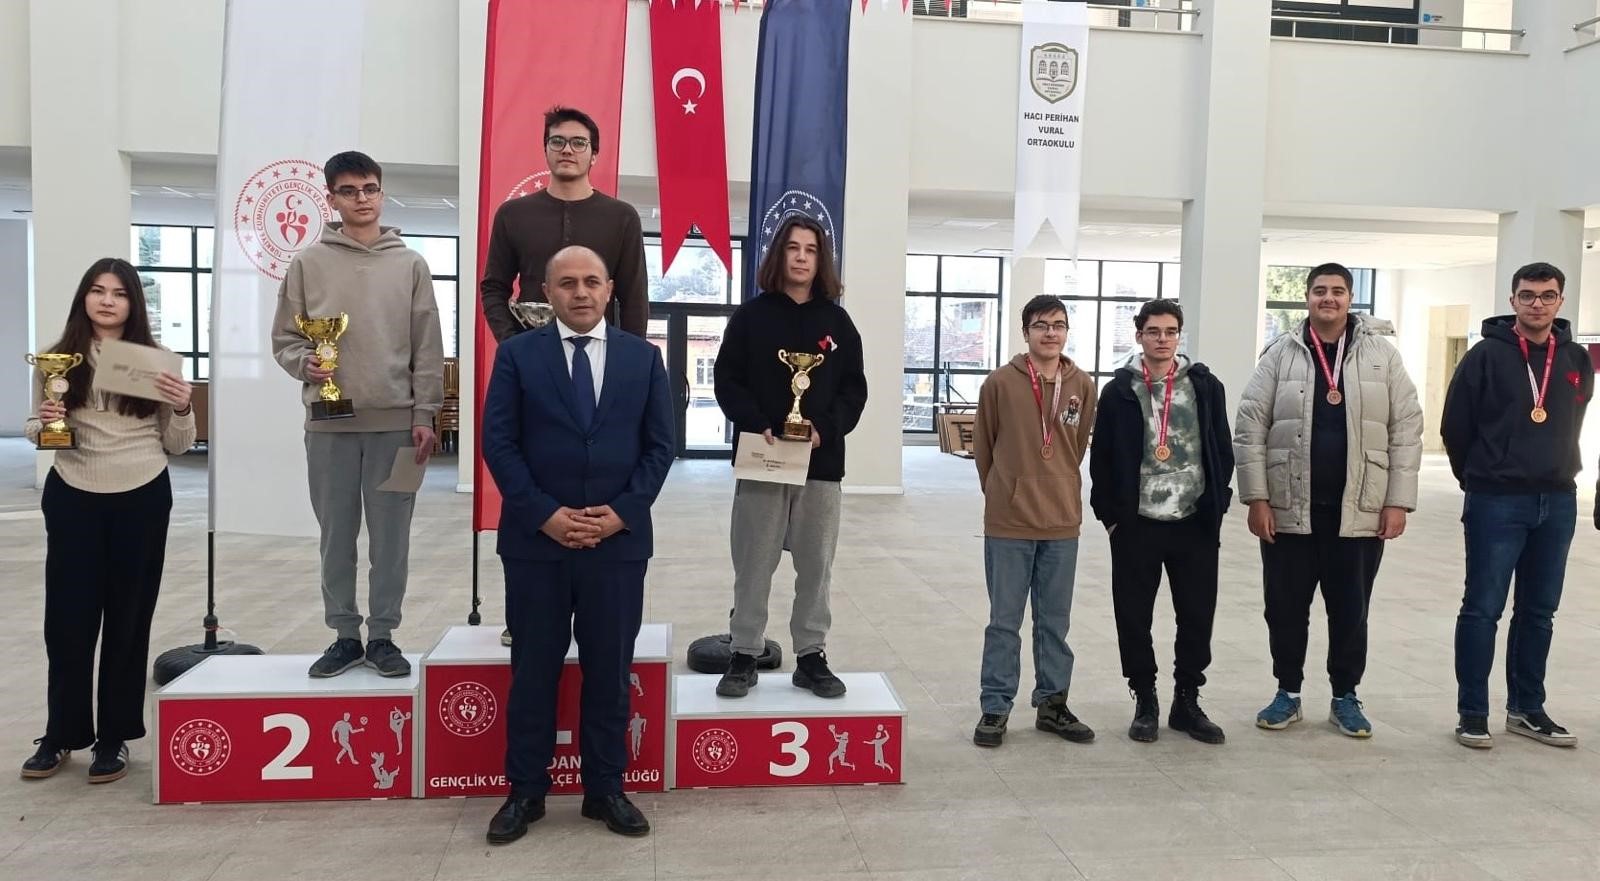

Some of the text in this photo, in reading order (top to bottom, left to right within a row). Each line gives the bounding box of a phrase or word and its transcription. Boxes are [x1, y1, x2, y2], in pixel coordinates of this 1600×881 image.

[1024, 112, 1079, 123] HACI PERİHAN
[1038, 126, 1064, 135] VURAL
[1027, 138, 1075, 148] ORTAOKULU
[313, 192, 322, 202] VE
[261, 713, 313, 780] 2
[769, 721, 810, 777] 3
[430, 773, 487, 790] GENÇLİK
[489, 775, 506, 786] VE
